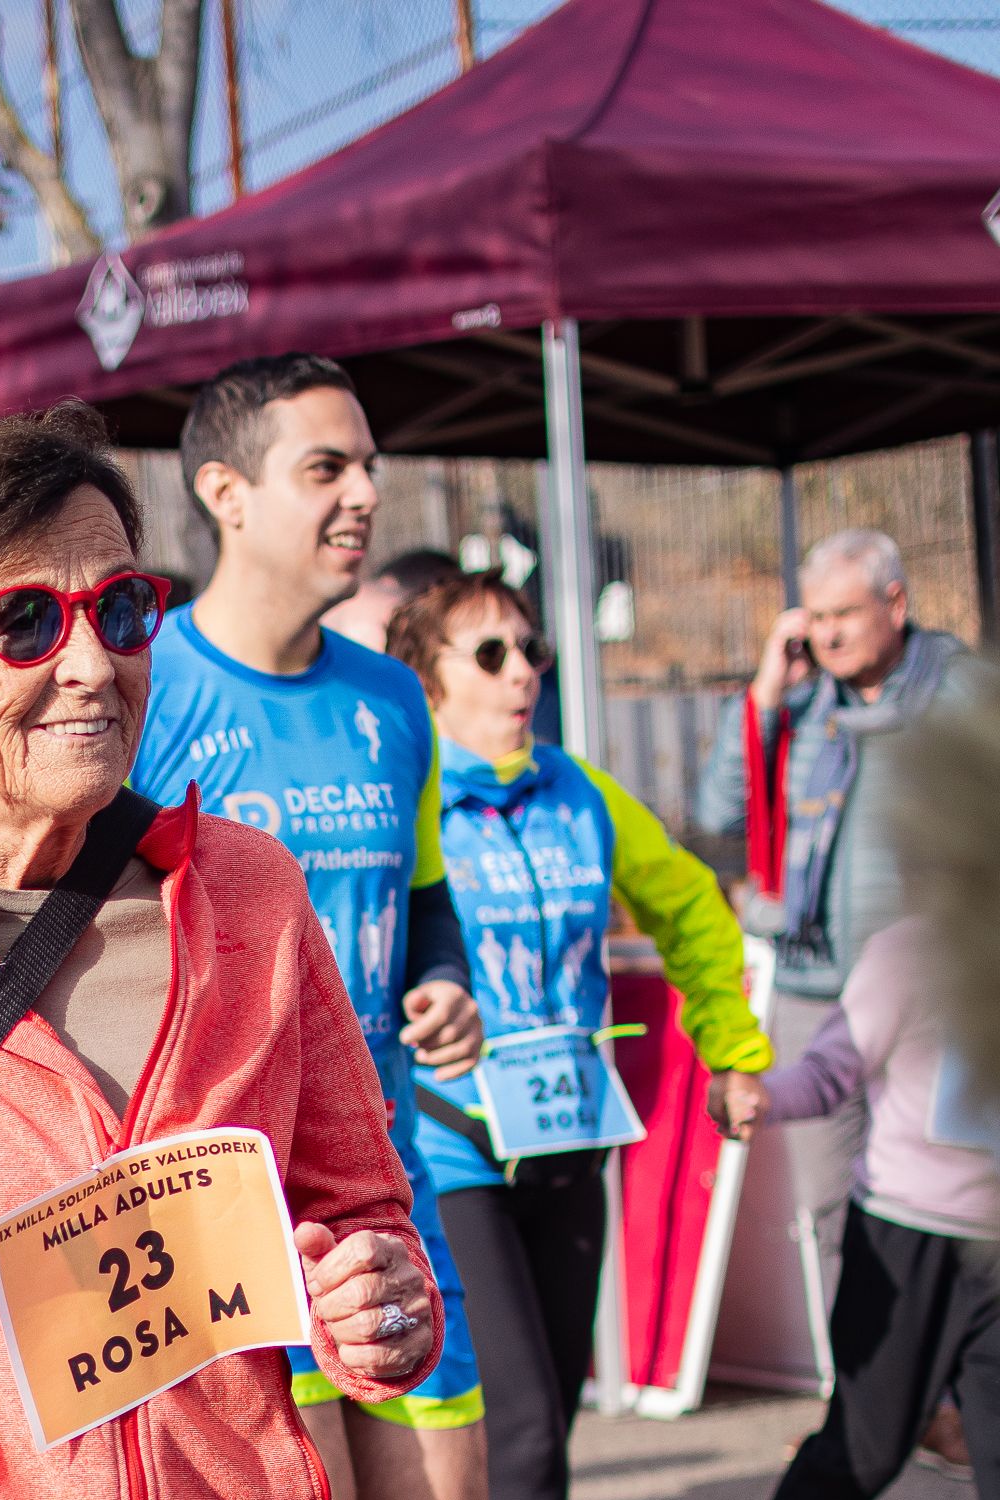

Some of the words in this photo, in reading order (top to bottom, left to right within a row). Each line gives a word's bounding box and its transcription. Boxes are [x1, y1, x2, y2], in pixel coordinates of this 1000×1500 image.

[283, 783, 395, 816] DECART
[0, 1228, 12, 1242] IX
[16, 1207, 55, 1233] MILLA
[59, 1171, 125, 1211] SOLIDÀRIA
[129, 1158, 151, 1176] DE
[156, 1141, 258, 1167] VALLDOREIX
[42, 1204, 108, 1251] MILLA
[115, 1168, 213, 1216] ADULTS
[98, 1229, 175, 1313] 23
[67, 1307, 189, 1393] ROSA
[208, 1283, 251, 1323] M
